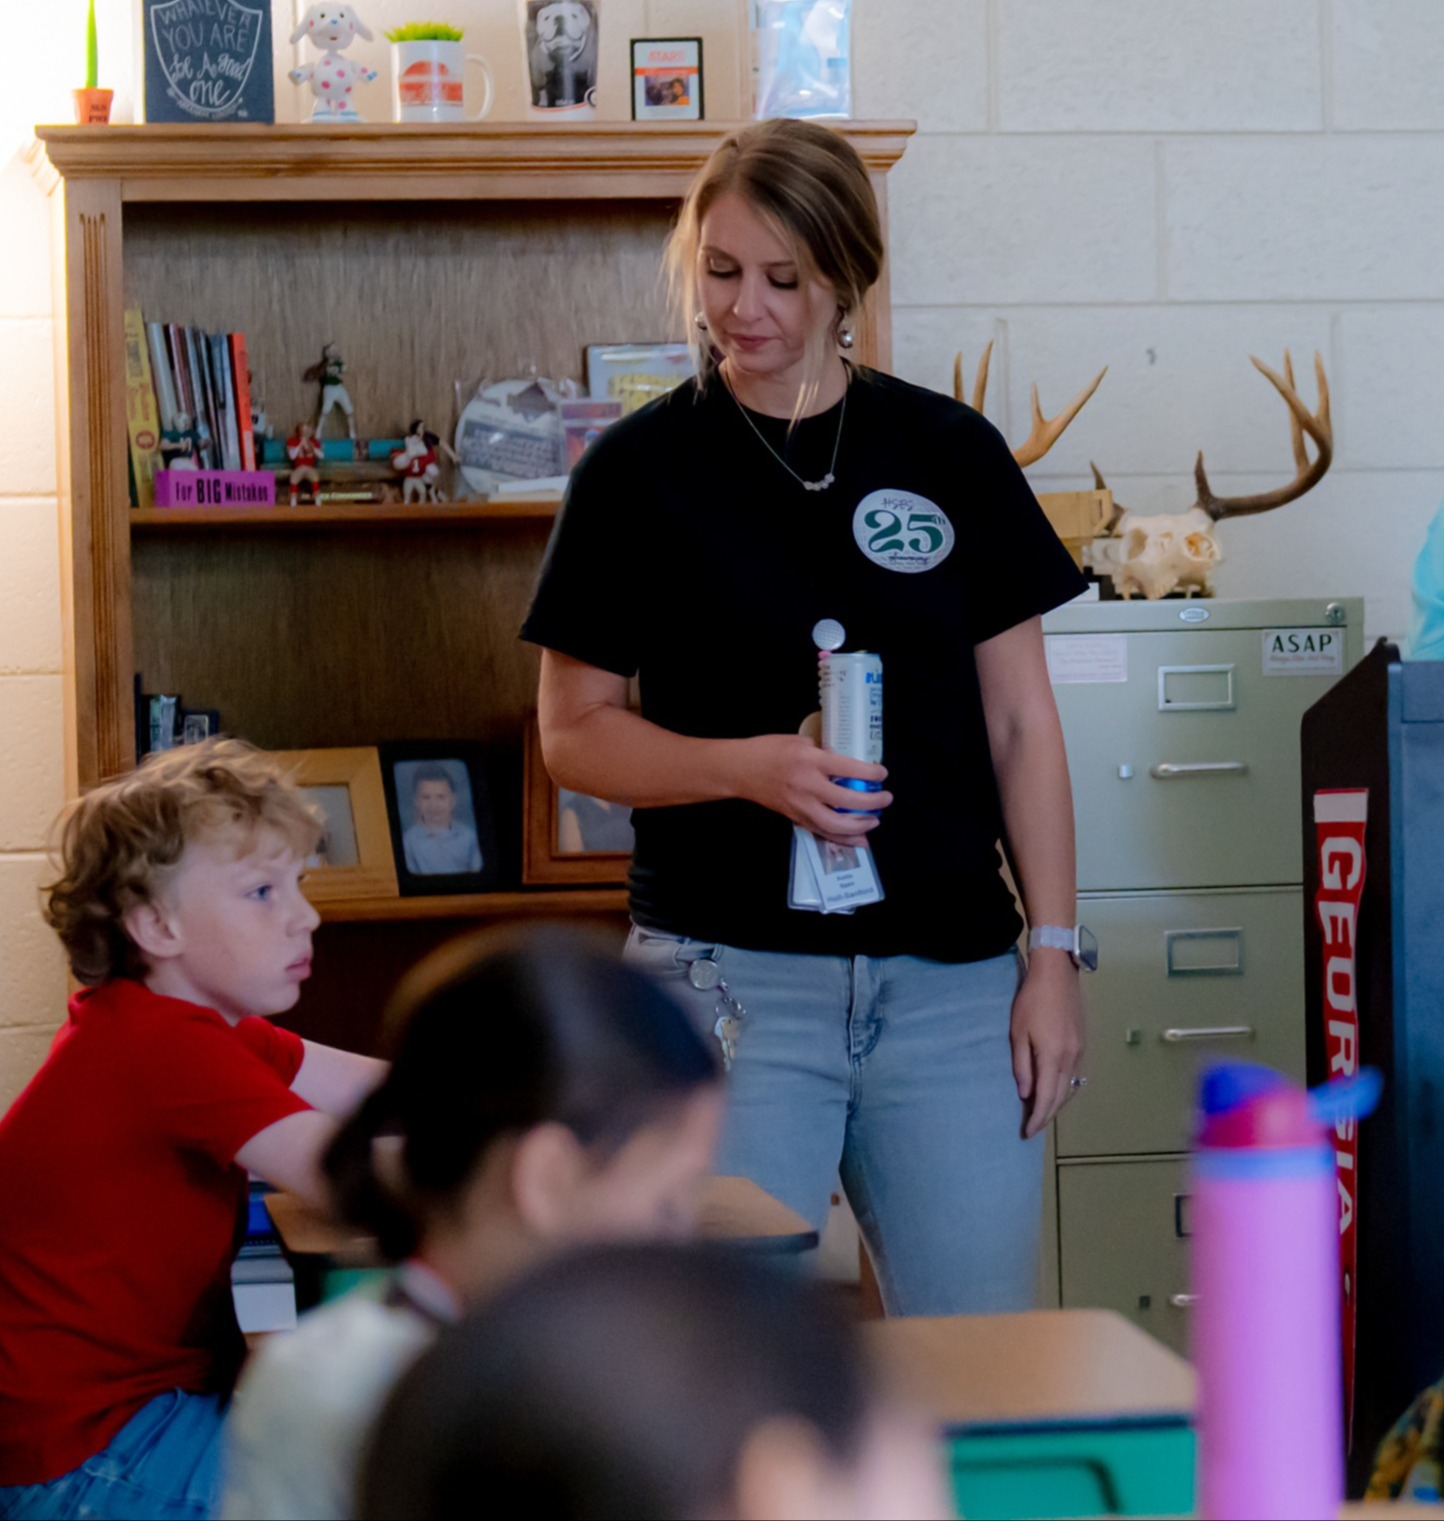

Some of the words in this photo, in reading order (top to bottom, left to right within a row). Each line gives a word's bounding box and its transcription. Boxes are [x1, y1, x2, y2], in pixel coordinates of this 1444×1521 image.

[161, 21, 204, 53] YOU
[209, 22, 246, 53] ARE
[175, 482, 193, 501] For
[196, 478, 222, 504] BIG
[1272, 633, 1333, 653] ASAP
